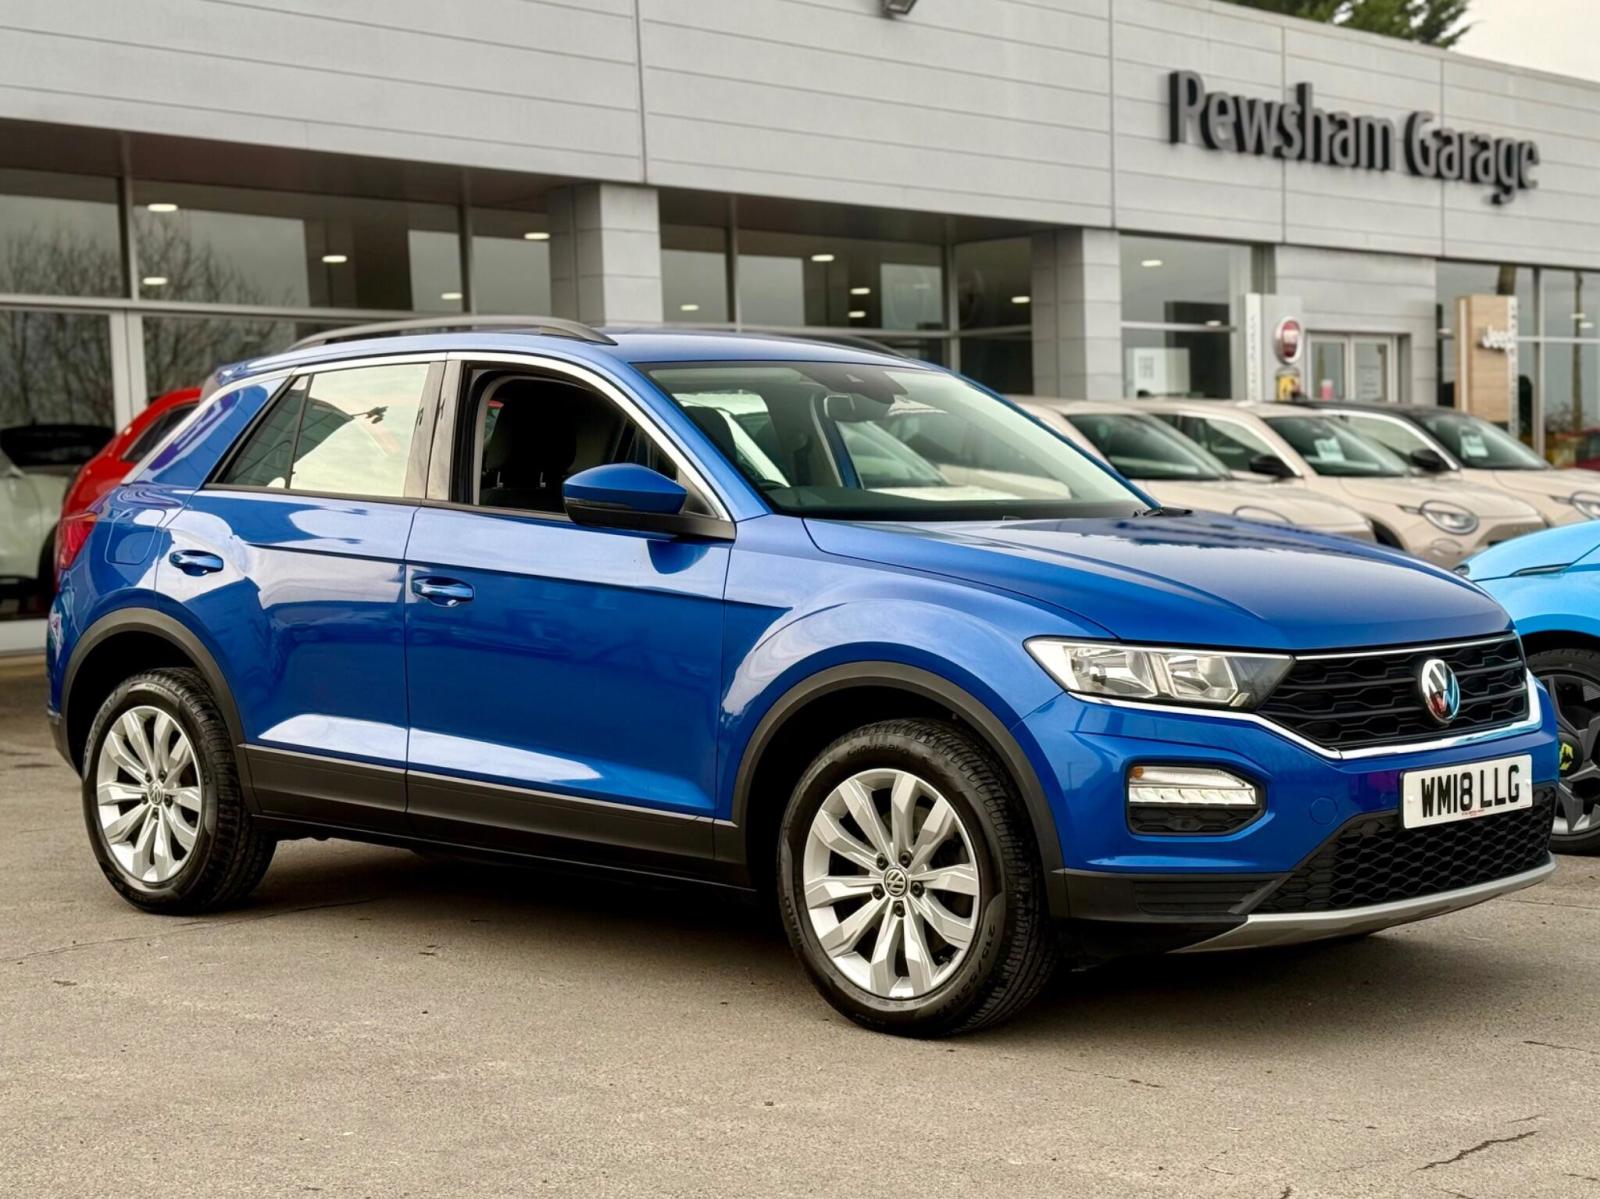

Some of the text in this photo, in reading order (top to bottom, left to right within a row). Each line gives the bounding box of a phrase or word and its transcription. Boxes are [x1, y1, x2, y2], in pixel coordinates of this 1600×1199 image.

[1169, 70, 1540, 205] Pewsham Garage
[1421, 764, 1520, 818] WM18 LLG
